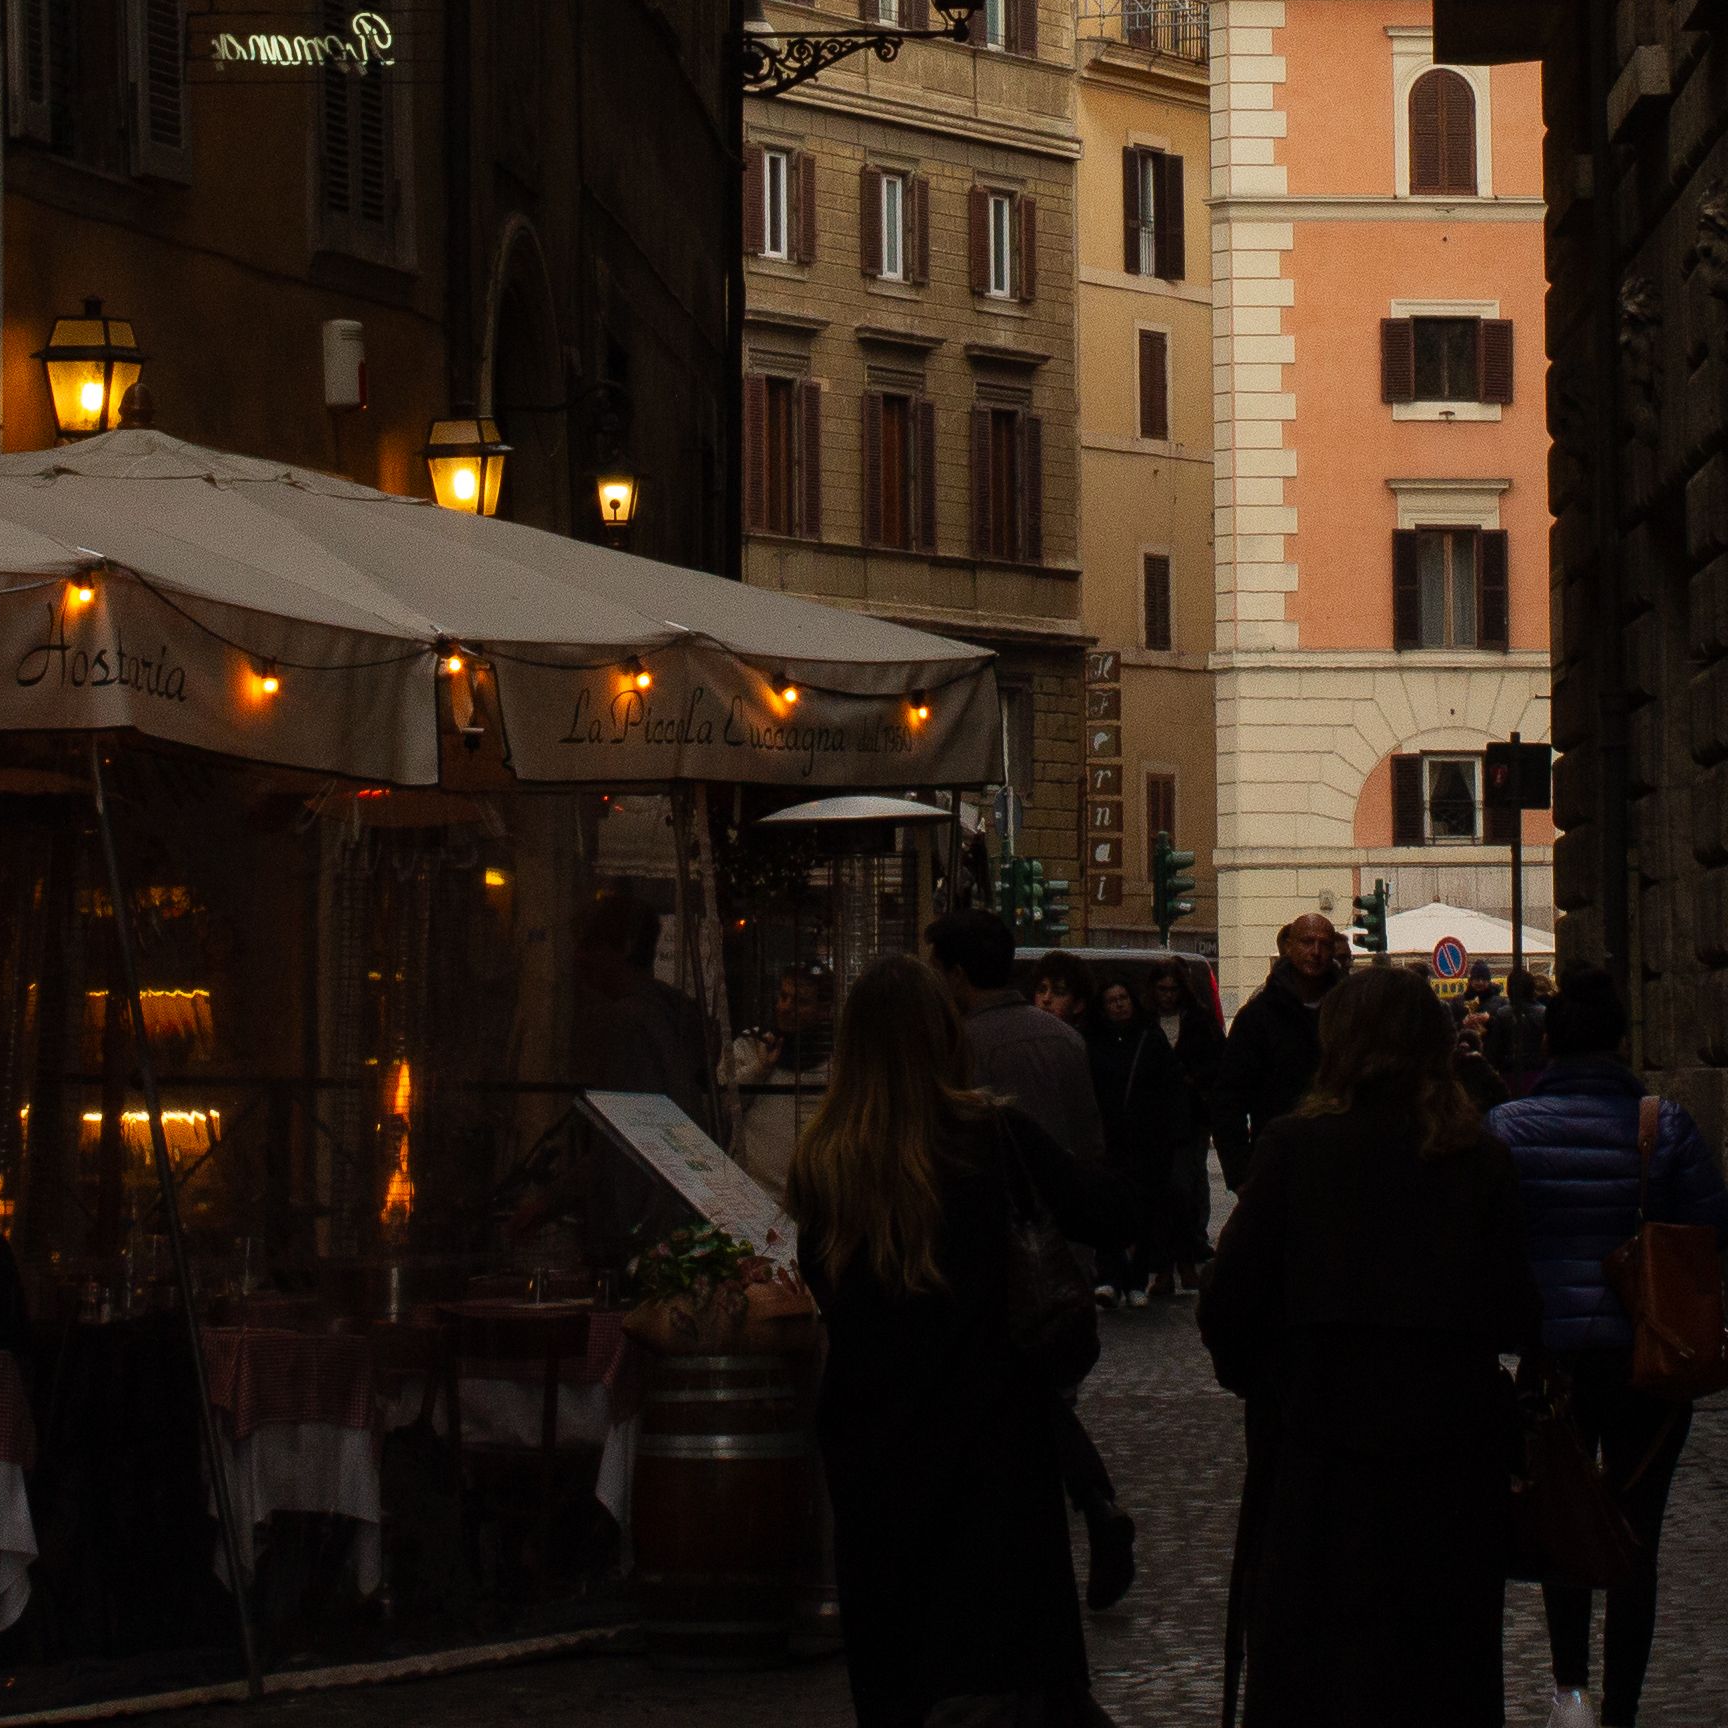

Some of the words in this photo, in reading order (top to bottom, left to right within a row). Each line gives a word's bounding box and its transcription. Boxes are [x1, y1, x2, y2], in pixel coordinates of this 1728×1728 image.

[15, 596, 188, 703] Hostaria
[558, 685, 604, 746] La
[610, 685, 714, 747] Piccola
[723, 694, 846, 778] Cuccagna
